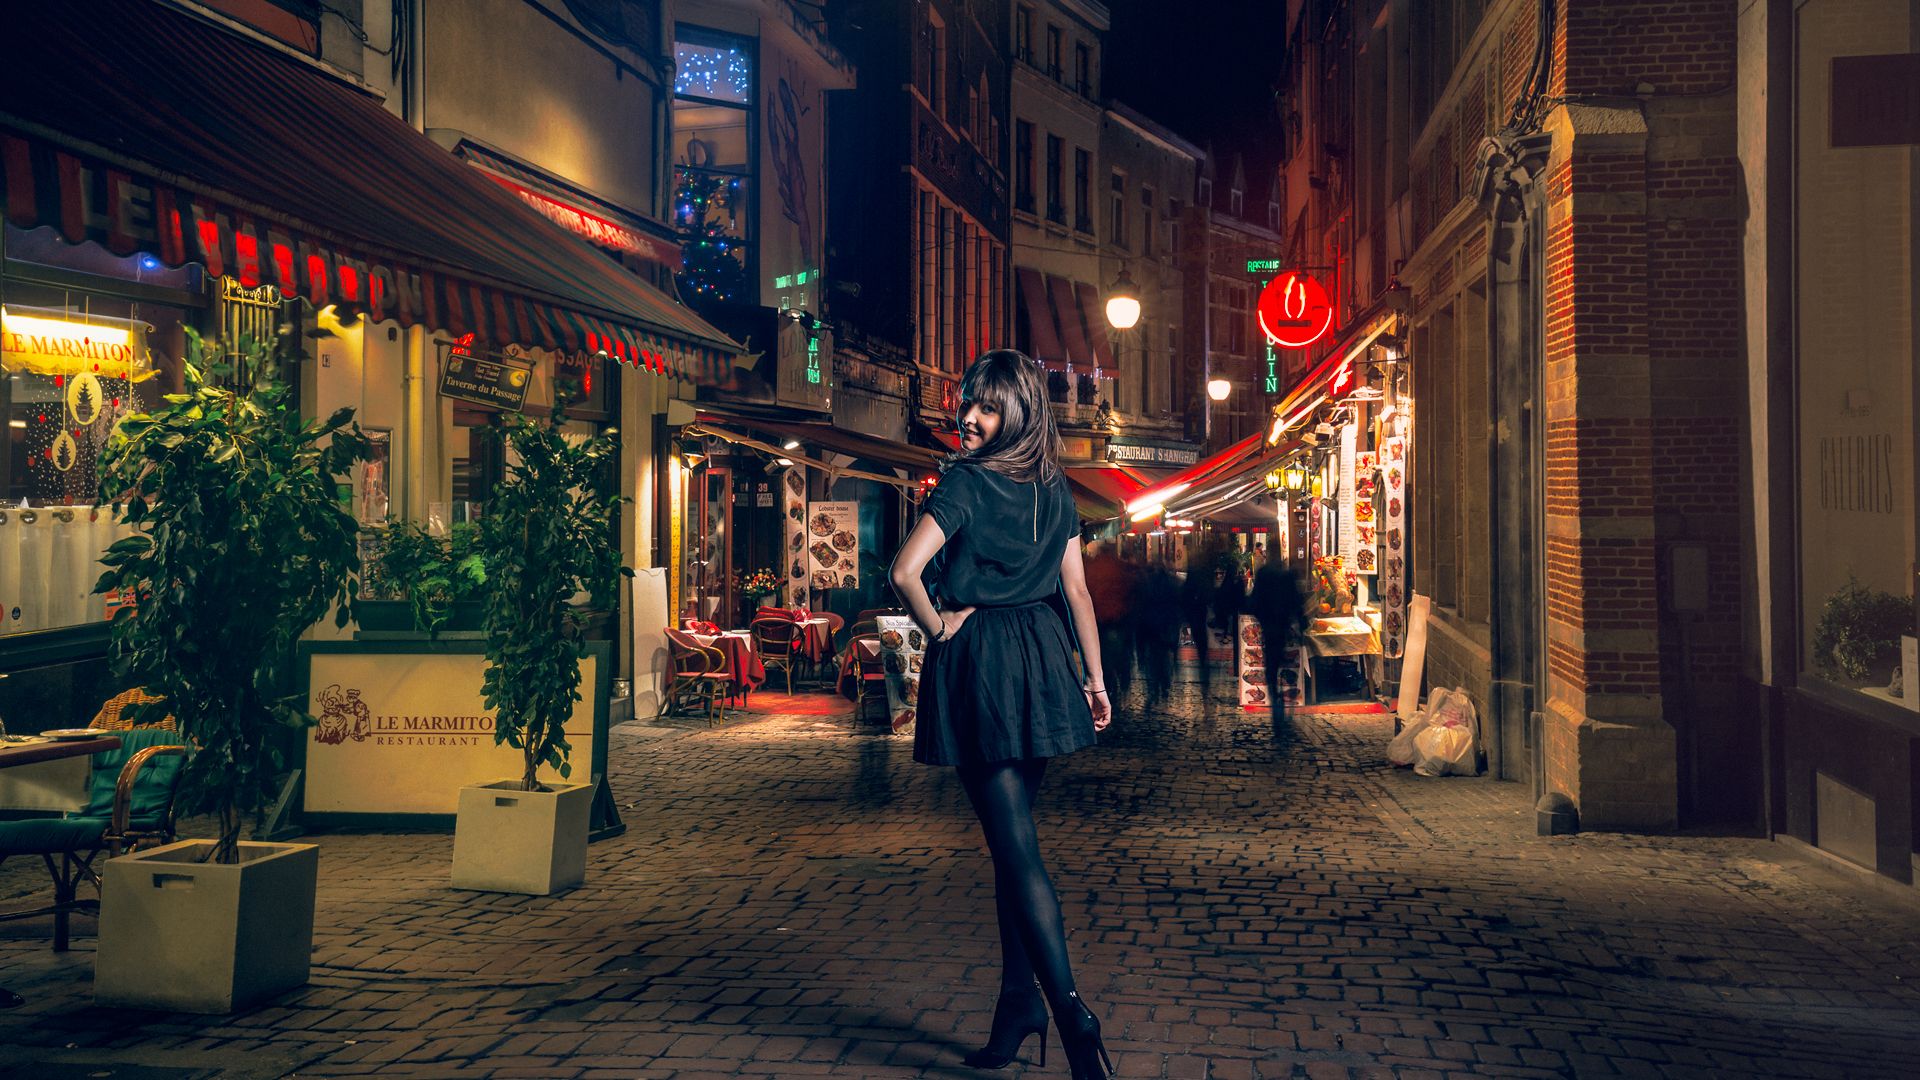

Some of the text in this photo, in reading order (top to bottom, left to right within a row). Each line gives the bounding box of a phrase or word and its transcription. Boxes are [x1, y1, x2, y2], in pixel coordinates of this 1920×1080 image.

[79, 167, 420, 316] LE MARMITON
[1, 332, 137, 364] LE MARMITON
[446, 375, 477, 391] Taverne
[478, 384, 489, 394] du
[490, 386, 522, 402] Passage
[1158, 447, 1197, 464] SHANGHAI
[757, 482, 768, 493] 39
[376, 716, 498, 730] LE MARMITO
[376, 736, 480, 746] RESTAURANT
